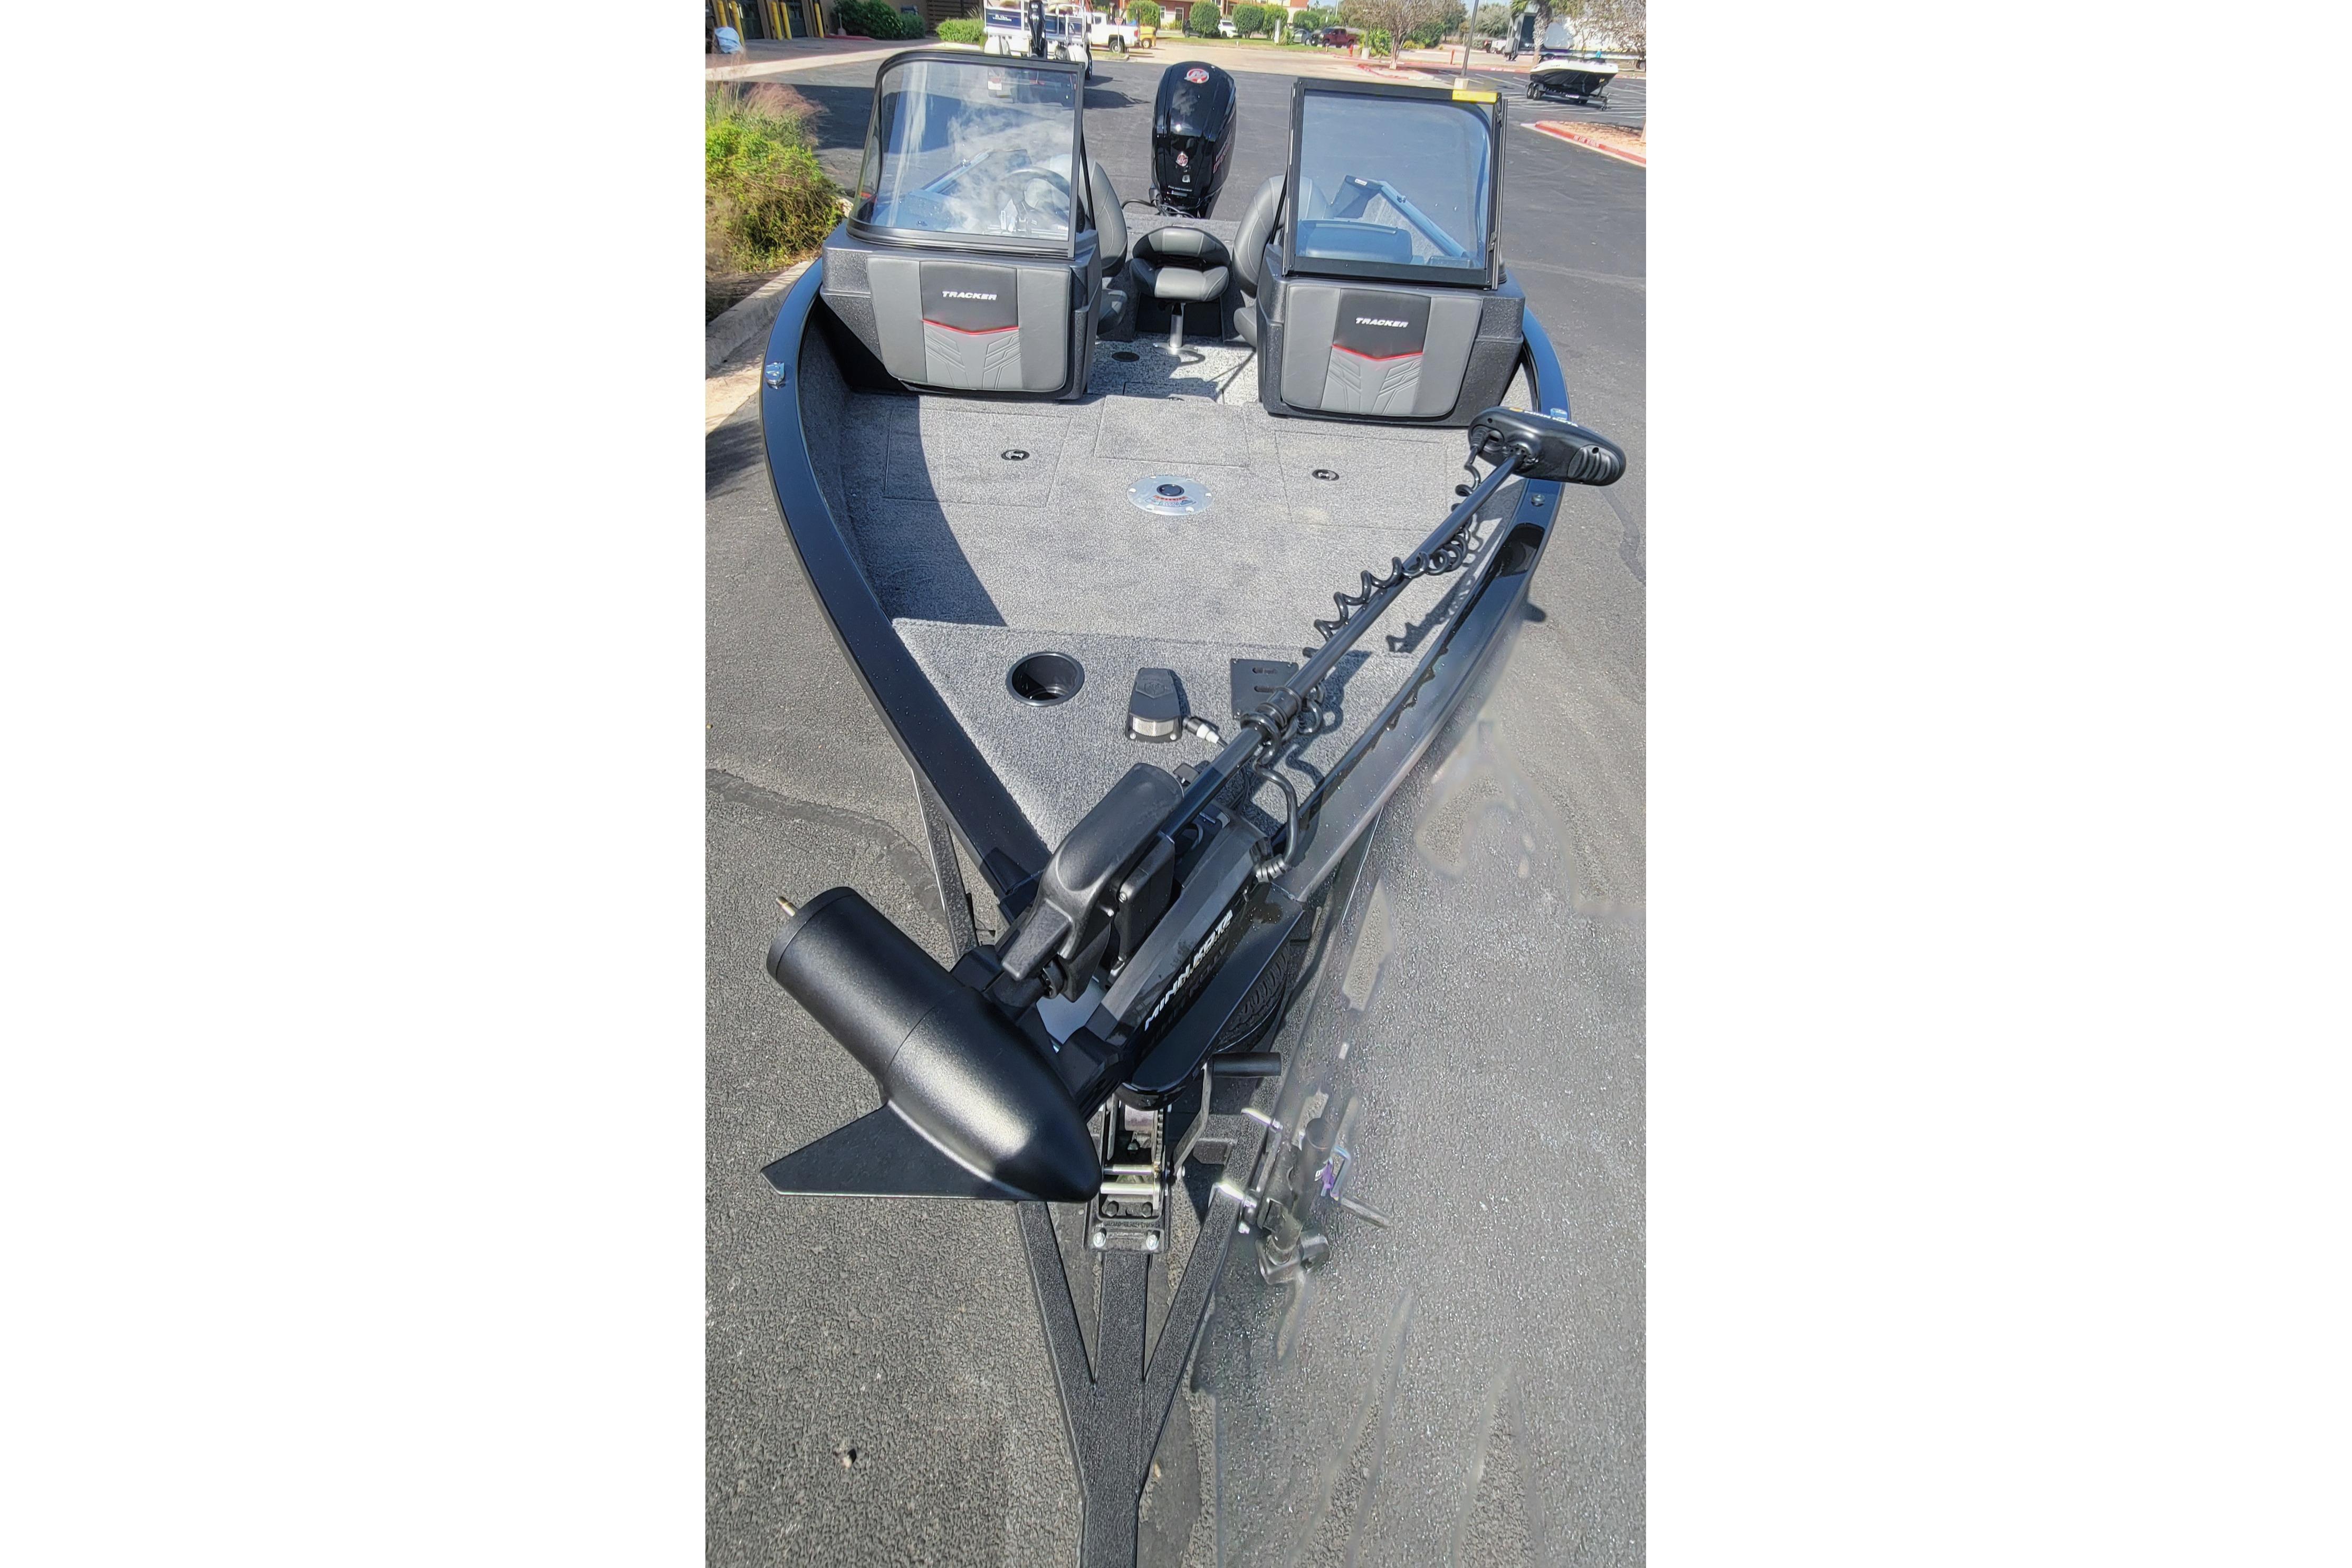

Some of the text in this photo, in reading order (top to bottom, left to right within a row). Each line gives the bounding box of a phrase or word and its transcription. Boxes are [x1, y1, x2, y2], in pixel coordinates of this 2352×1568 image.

[942, 291, 997, 300] TRACKER
[1356, 318, 1409, 328] TRACKER
[1144, 909, 1233, 1032] MINN KOTA
